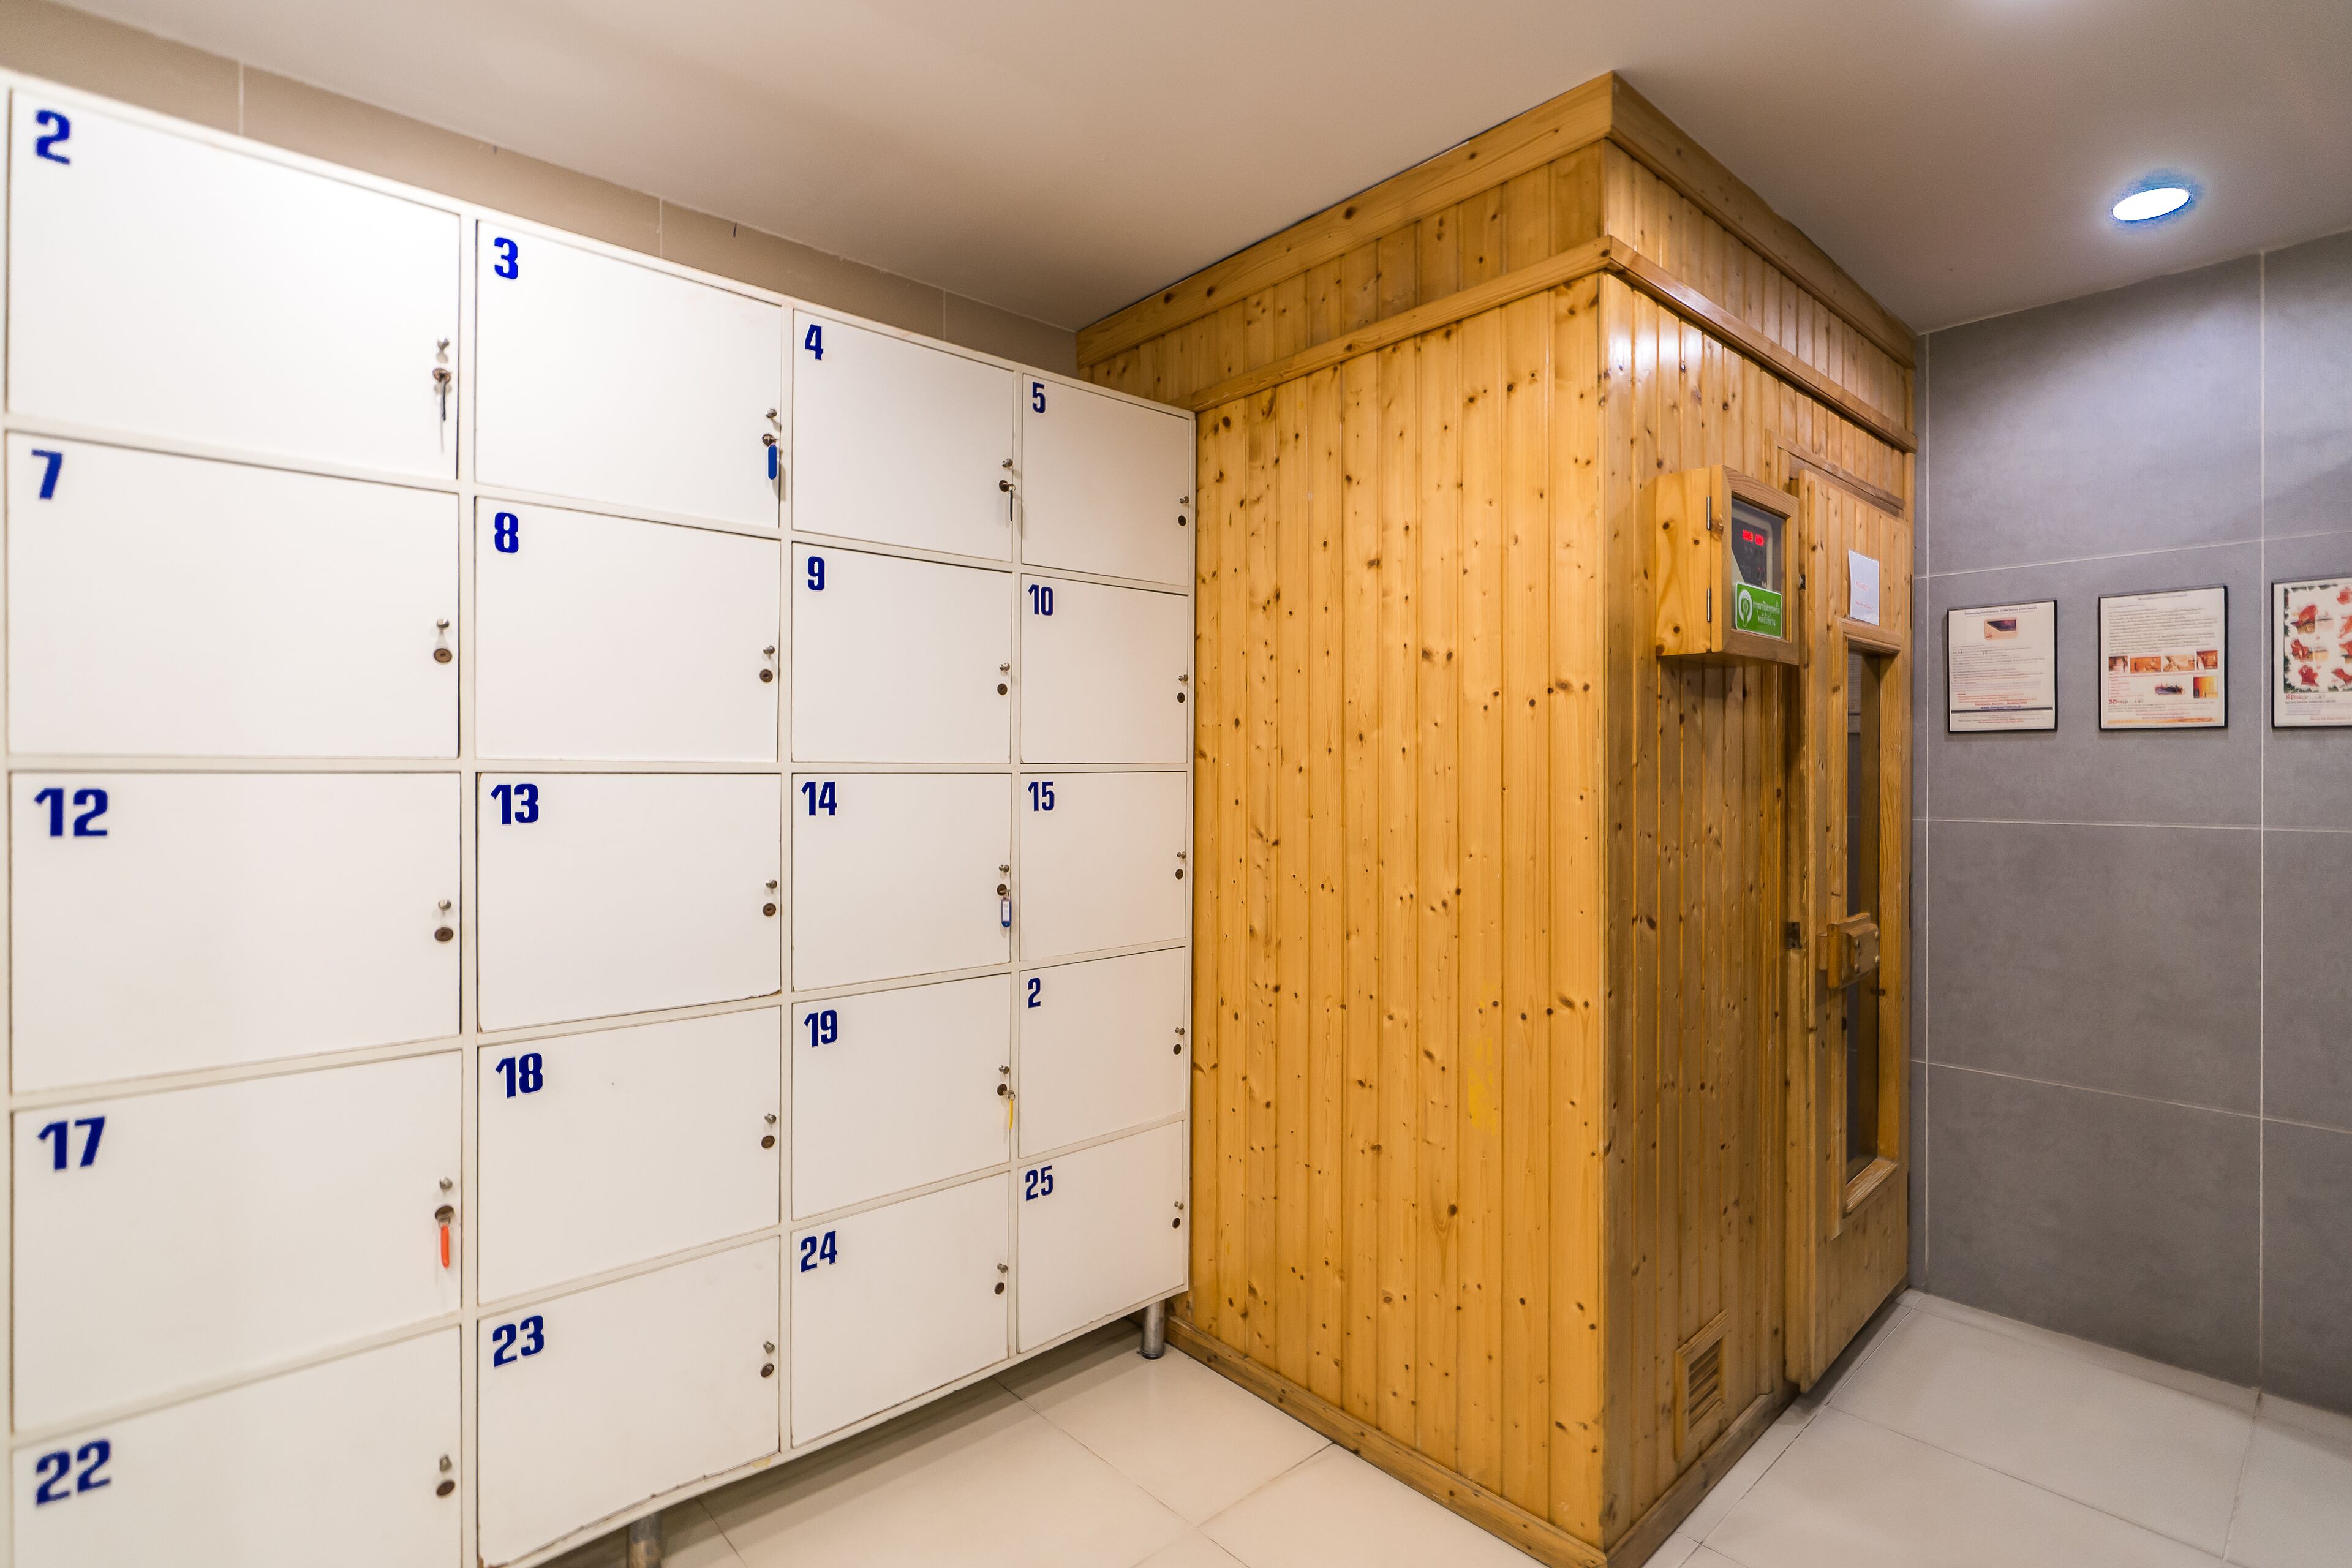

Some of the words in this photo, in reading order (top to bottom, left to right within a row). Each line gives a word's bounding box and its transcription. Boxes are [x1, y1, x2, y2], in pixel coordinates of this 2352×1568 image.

[36, 110, 70, 164] 2
[494, 237, 518, 279] 3
[805, 324, 823, 360] 4
[1033, 383, 1044, 412] 5
[32, 450, 62, 500] 7
[494, 512, 519, 553] 8
[808, 556, 824, 590] 9
[1029, 584, 1053, 615] 10
[34, 788, 108, 837] 12
[491, 784, 538, 824] 13
[801, 782, 837, 815] 14
[1028, 782, 1054, 811] 15
[1028, 978, 1040, 1008] 2
[804, 1010, 837, 1047] 19
[496, 1053, 543, 1098] 18
[37, 1116, 105, 1170] 17
[1025, 1166, 1052, 1200] 25
[801, 1231, 837, 1272] 24
[493, 1316, 544, 1367] 23
[36, 1440, 110, 1505] 22
